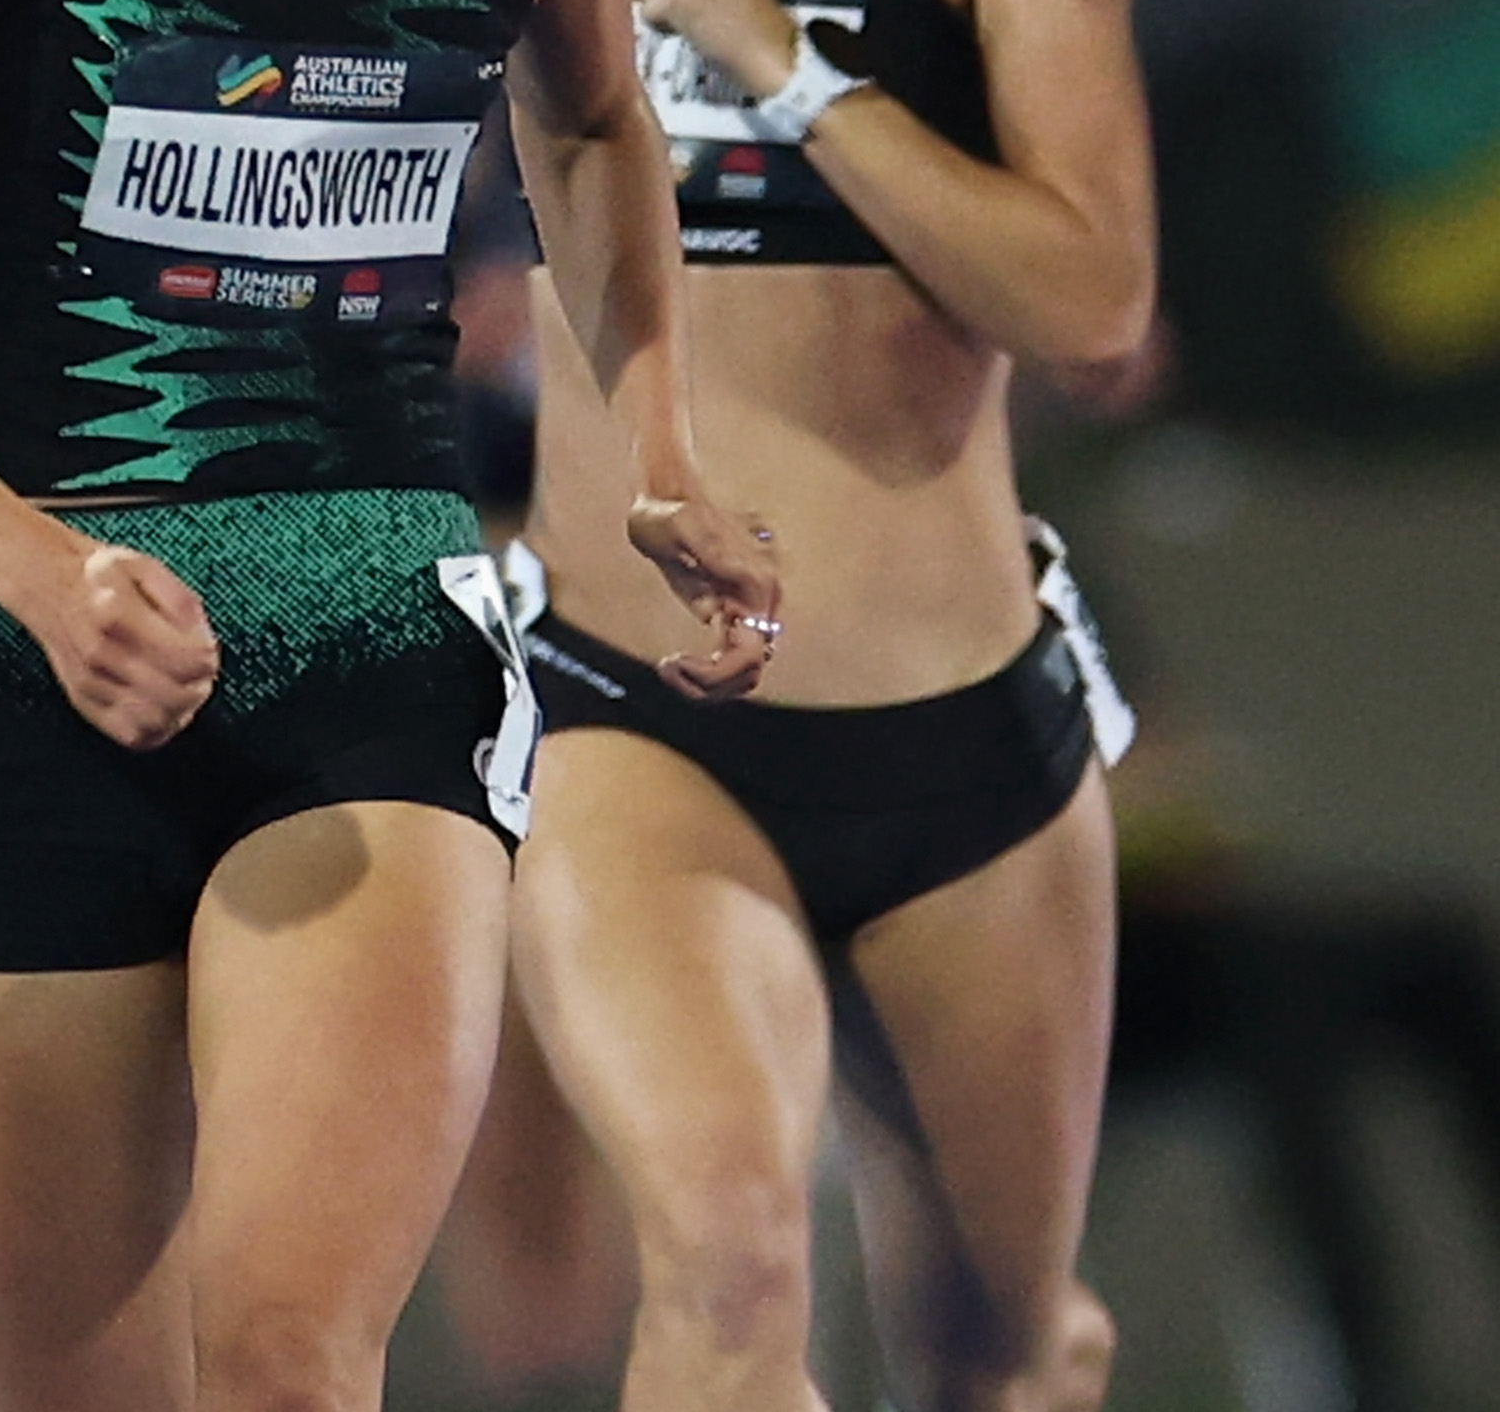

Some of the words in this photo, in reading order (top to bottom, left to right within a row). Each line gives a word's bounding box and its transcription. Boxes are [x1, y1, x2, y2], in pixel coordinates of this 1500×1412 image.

[293, 54, 407, 76] AUSTRALIAN
[291, 73, 404, 96] ATHLETICS
[116, 139, 452, 229] HOLLINGSWORTH
[219, 267, 317, 294] SUMMER
[216, 287, 288, 309] SERIES
[338, 295, 381, 314] NSW
